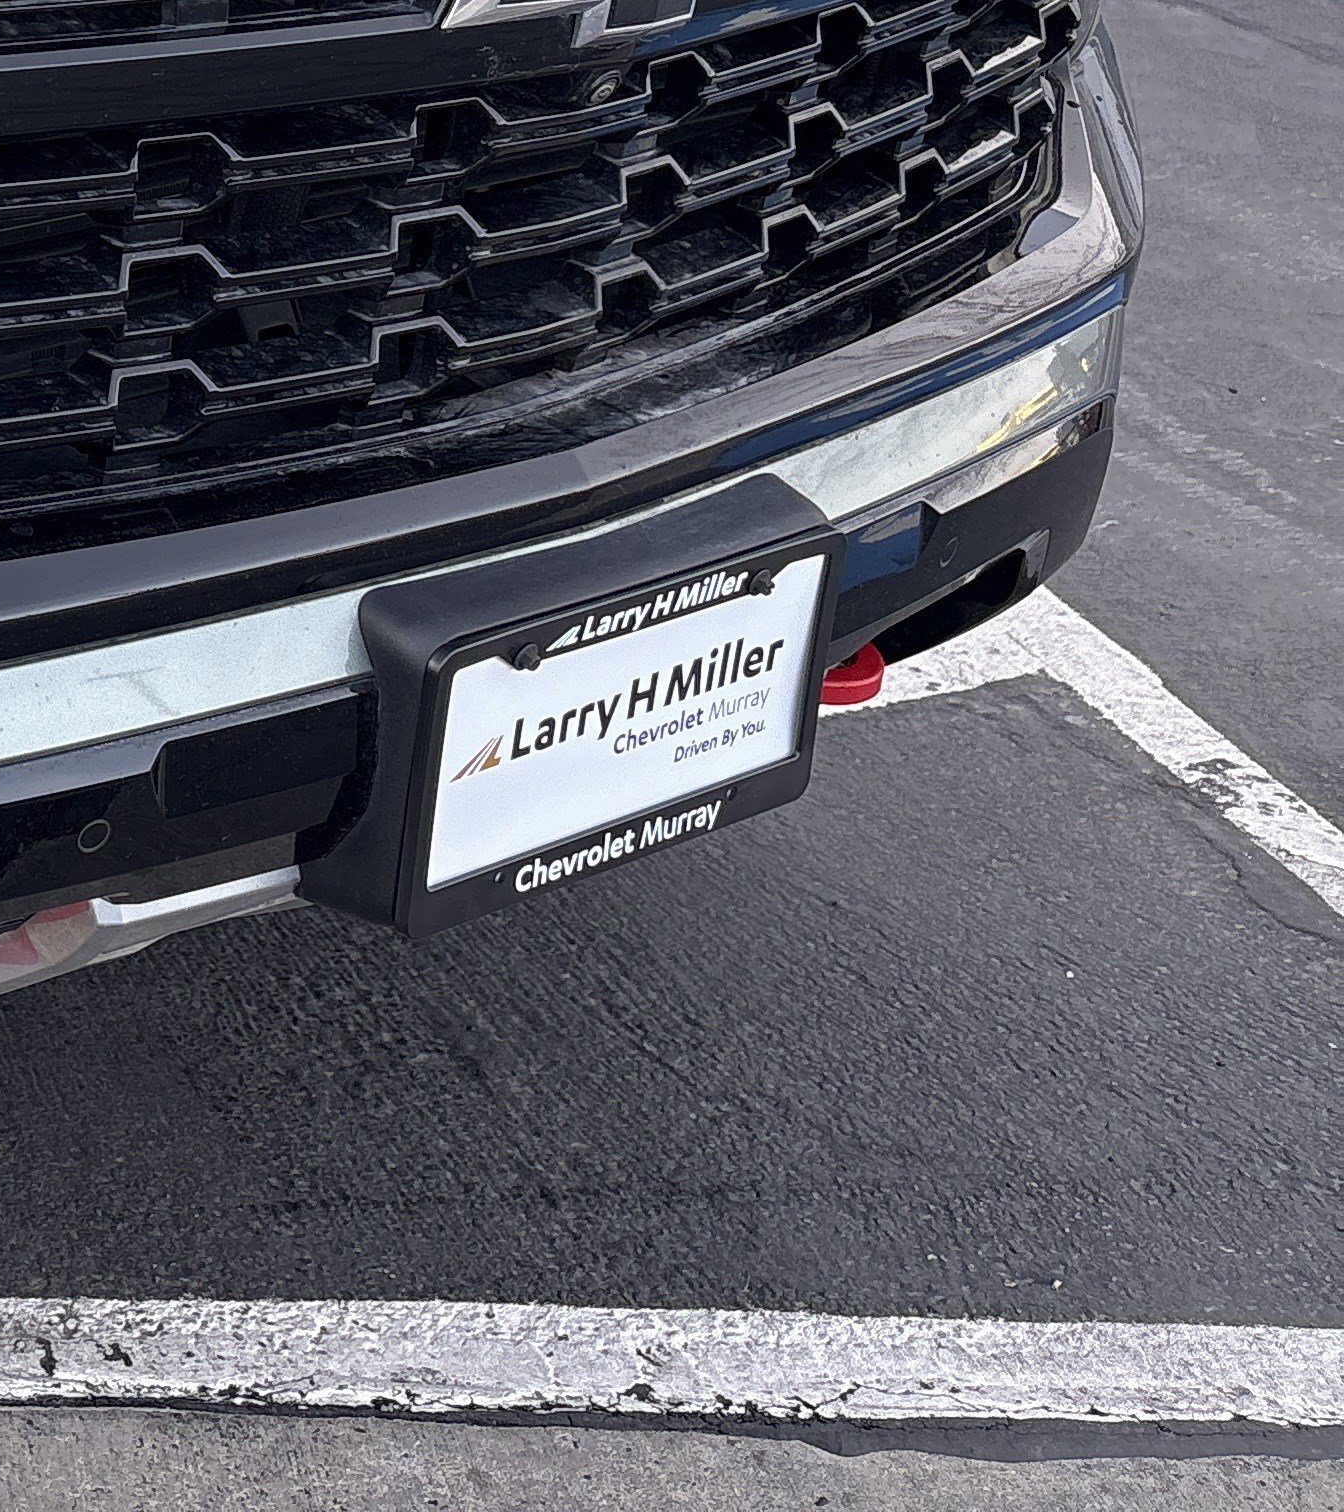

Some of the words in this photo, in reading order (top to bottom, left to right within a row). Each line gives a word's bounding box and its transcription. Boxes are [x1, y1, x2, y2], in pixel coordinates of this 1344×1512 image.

[581, 601, 652, 632] Larry
[651, 590, 676, 620] H
[674, 571, 749, 611] Miller
[510, 692, 622, 761] Larry
[626, 671, 660, 720] H
[663, 637, 784, 707] Miller
[613, 708, 704, 755] Chevrolet
[708, 687, 771, 723] Murray
[674, 736, 718, 763] Driven
[721, 728, 739, 747] By
[515, 829, 635, 893] Chevrolet
[639, 800, 722, 850] Murray
